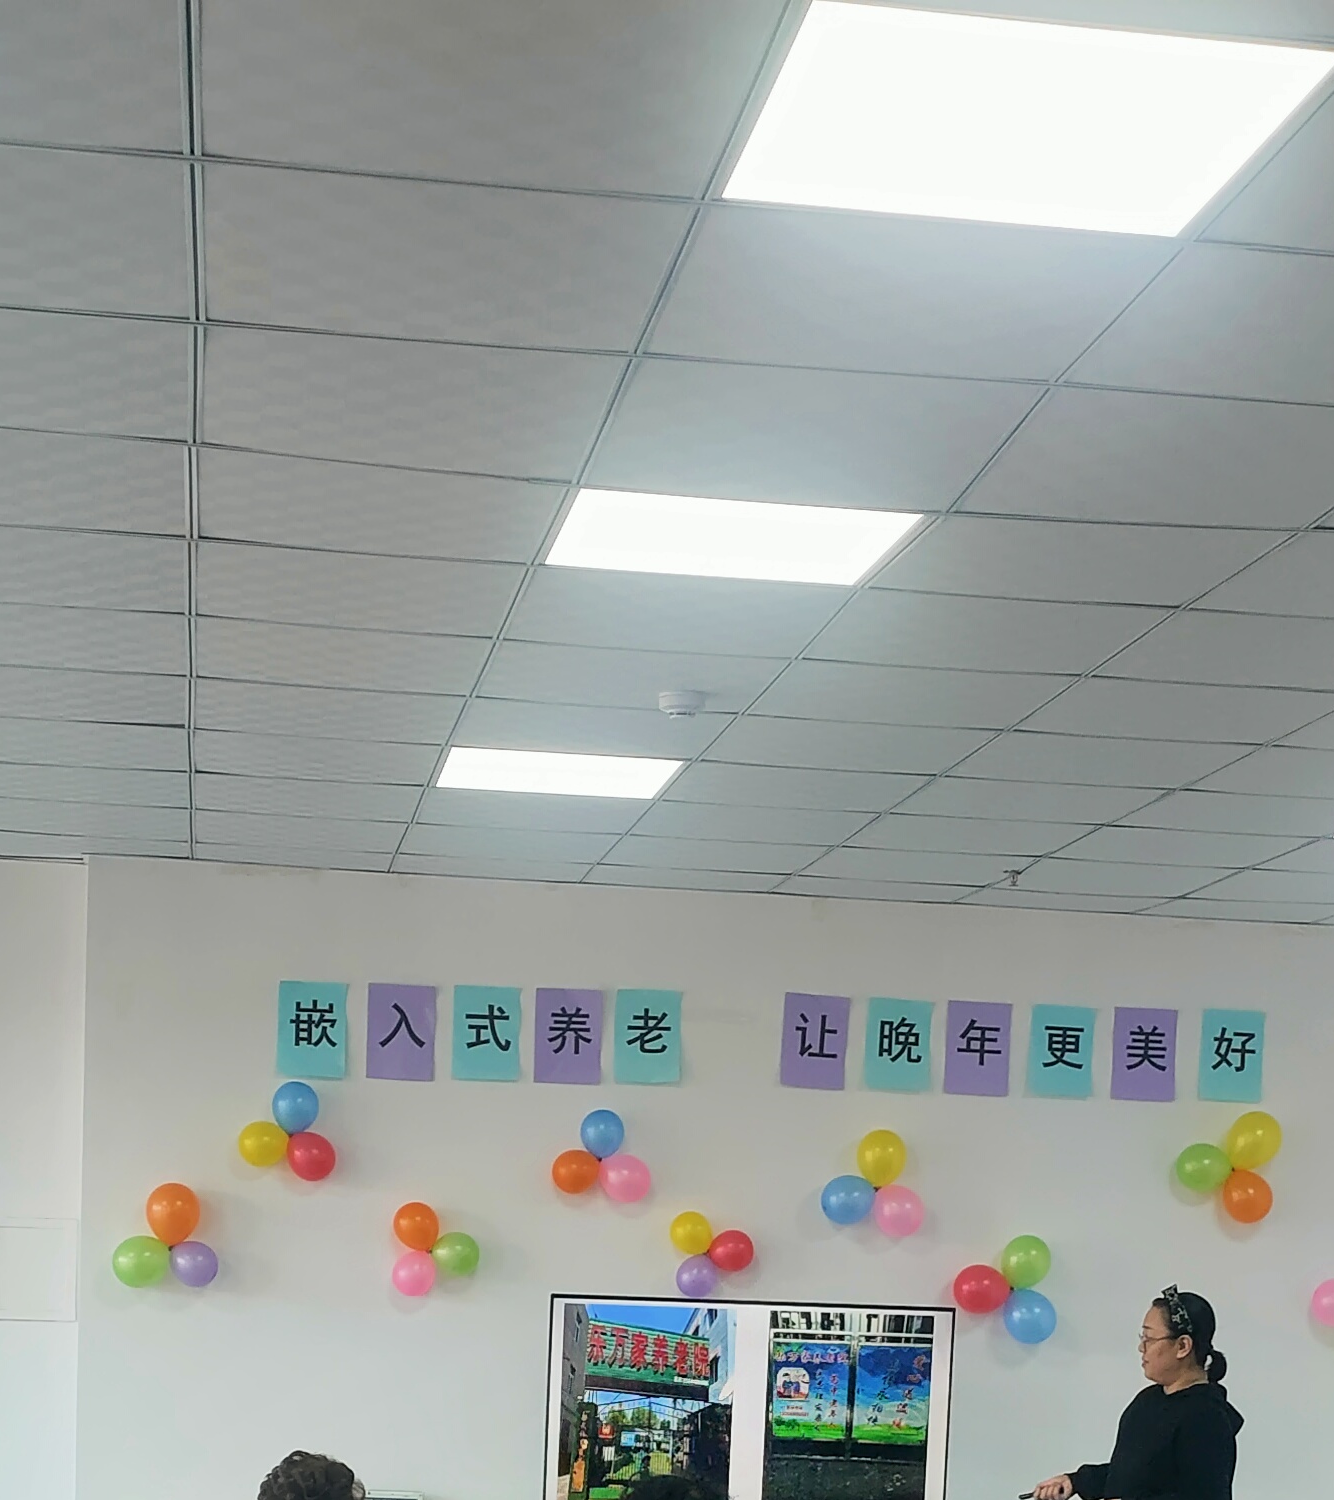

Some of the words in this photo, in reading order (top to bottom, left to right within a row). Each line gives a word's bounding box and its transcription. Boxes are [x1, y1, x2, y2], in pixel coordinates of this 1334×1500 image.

[289, 999, 672, 1055] 嵌入式养老
[795, 1012, 1257, 1073] 让晚年更美好
